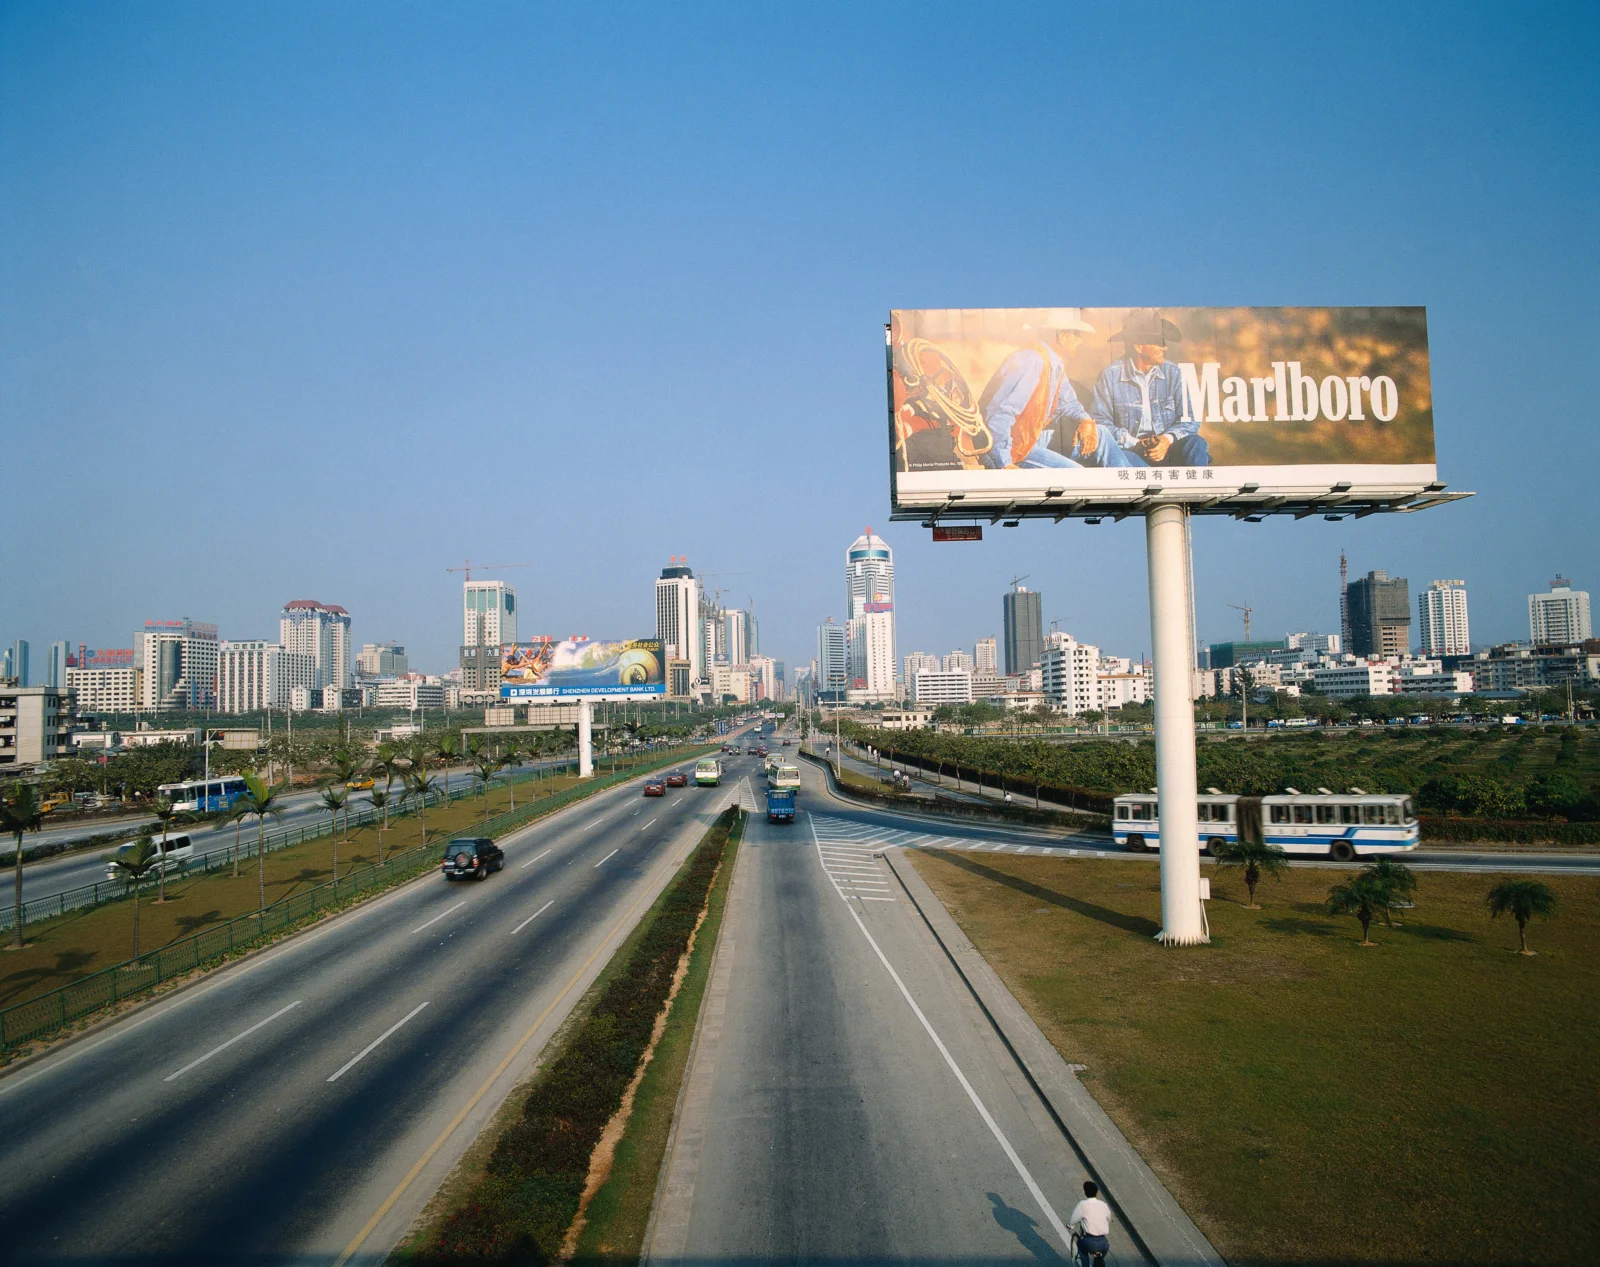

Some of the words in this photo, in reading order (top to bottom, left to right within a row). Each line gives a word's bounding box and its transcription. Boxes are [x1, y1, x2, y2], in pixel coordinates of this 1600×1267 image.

[1178, 361, 1398, 422] Marlboro
[1118, 470, 1214, 480] 吸烟有害健康
